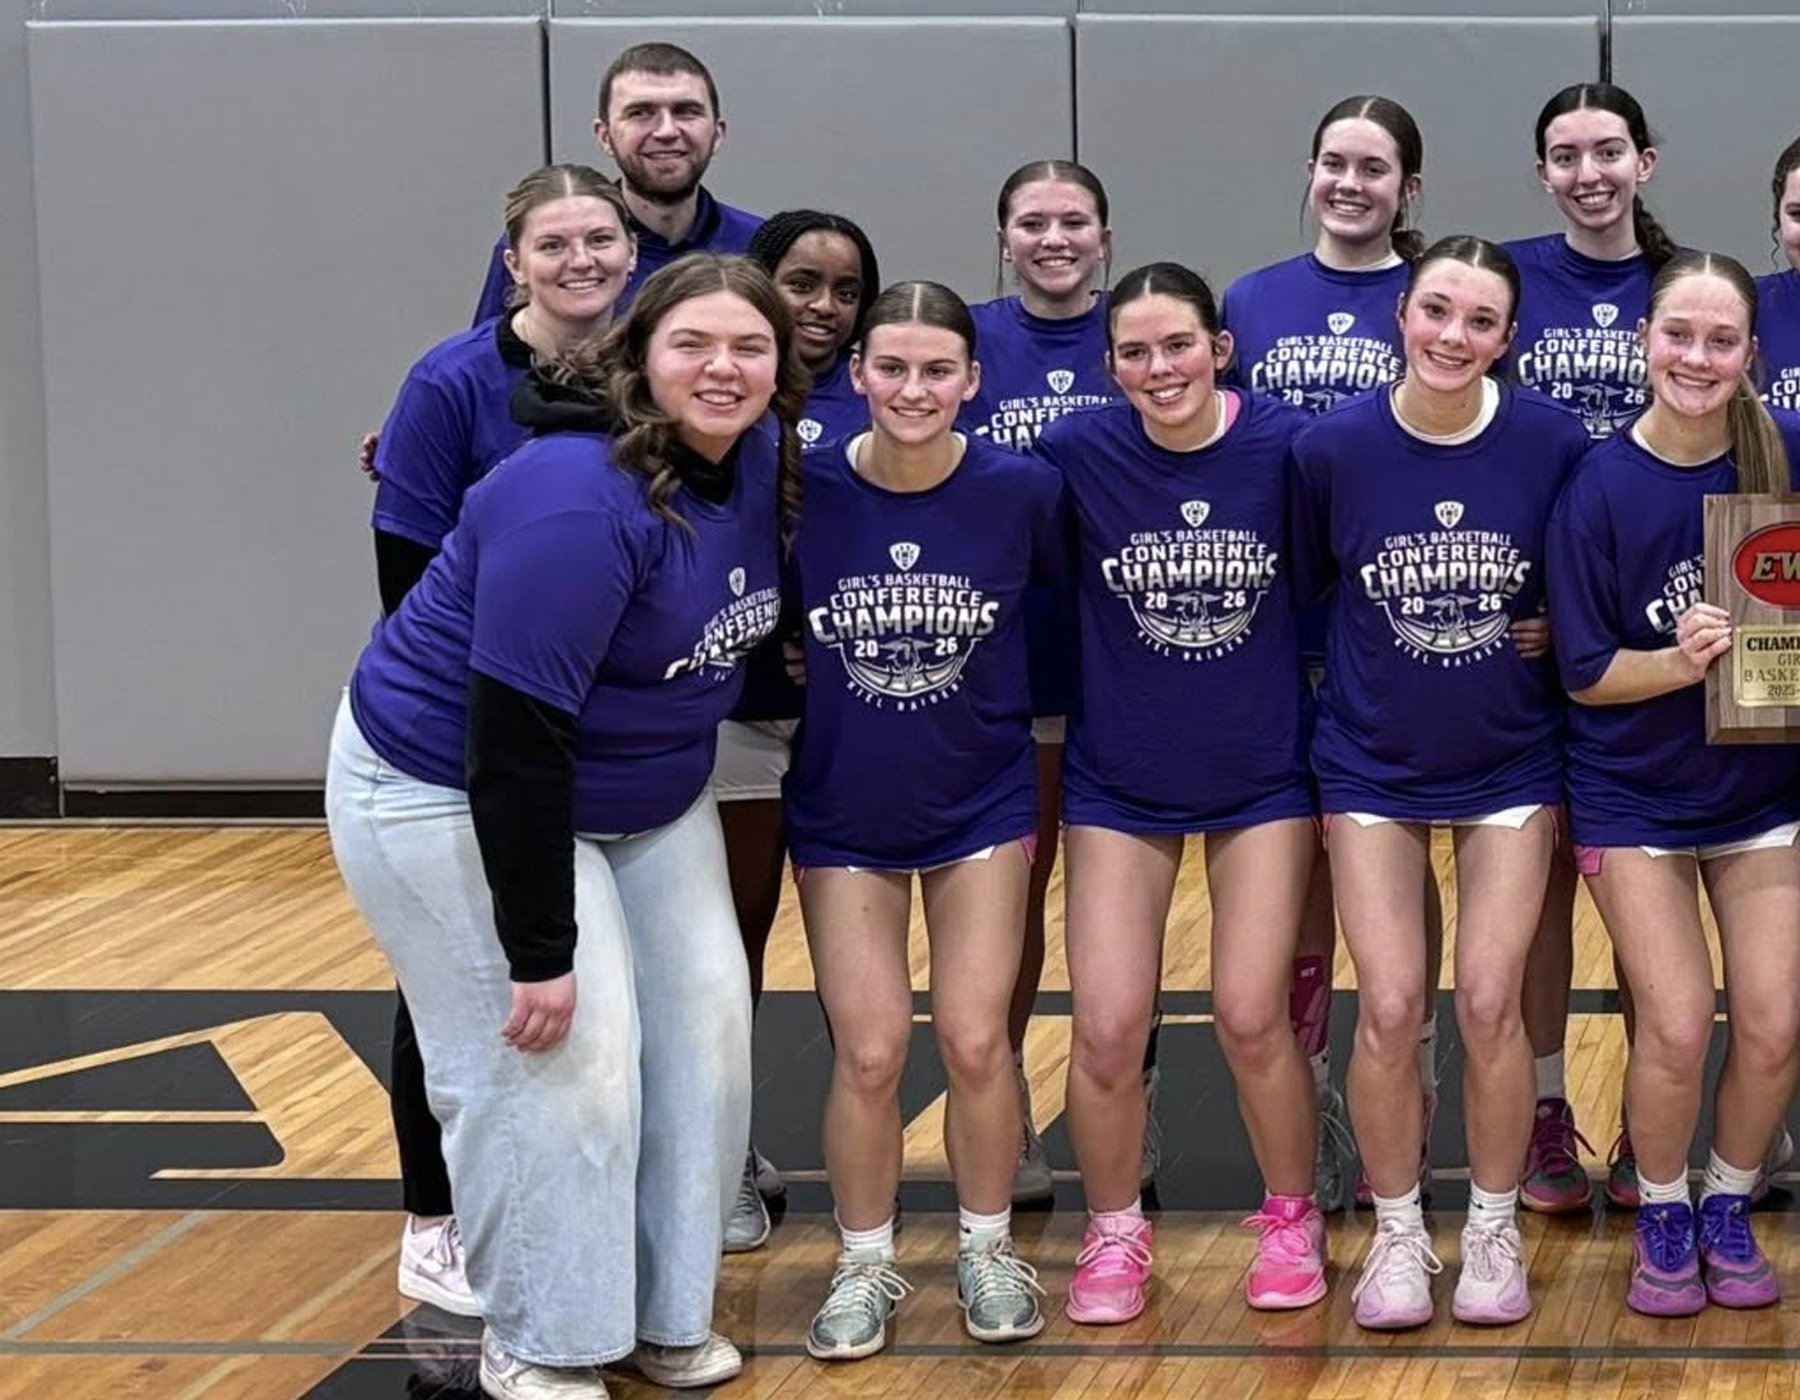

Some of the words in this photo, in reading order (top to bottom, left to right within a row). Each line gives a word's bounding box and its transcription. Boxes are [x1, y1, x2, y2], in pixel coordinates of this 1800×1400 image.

[1277, 335, 1315, 348] GIRL'S
[1318, 336, 1393, 354] BASKETBALL
[1544, 328, 1582, 339] GIRL'S
[1585, 329, 1637, 341] BASKET
[1266, 346, 1402, 372] CONFERENCE
[1534, 339, 1645, 358] CONFEREN
[1518, 352, 1646, 386] CHAMPIO
[1551, 382, 1573, 399] 20
[1623, 387, 1645, 404] 26
[999, 397, 1038, 411] GIRL'S
[1130, 530, 1172, 546] GIRL'S
[1176, 528, 1258, 543] BASKETBALL
[1384, 533, 1427, 549] GIRL'S
[1430, 531, 1511, 547] BASKETBALL
[1121, 542, 1267, 564] CONFERENCE
[1378, 544, 1520, 568] CONFERENCE
[837, 573, 881, 591] GIRL'S
[885, 573, 972, 589] BASKETBALL
[1101, 552, 1278, 593] CHAMPIONS
[830, 586, 983, 610] CONFERENCE
[1145, 592, 1168, 609] 20
[1223, 590, 1246, 608] 26
[1401, 597, 1424, 615] 20
[1478, 594, 1502, 611] 26
[808, 601, 999, 643] CHAMPIONS
[854, 640, 879, 658] 20
[935, 636, 958, 656] 26
